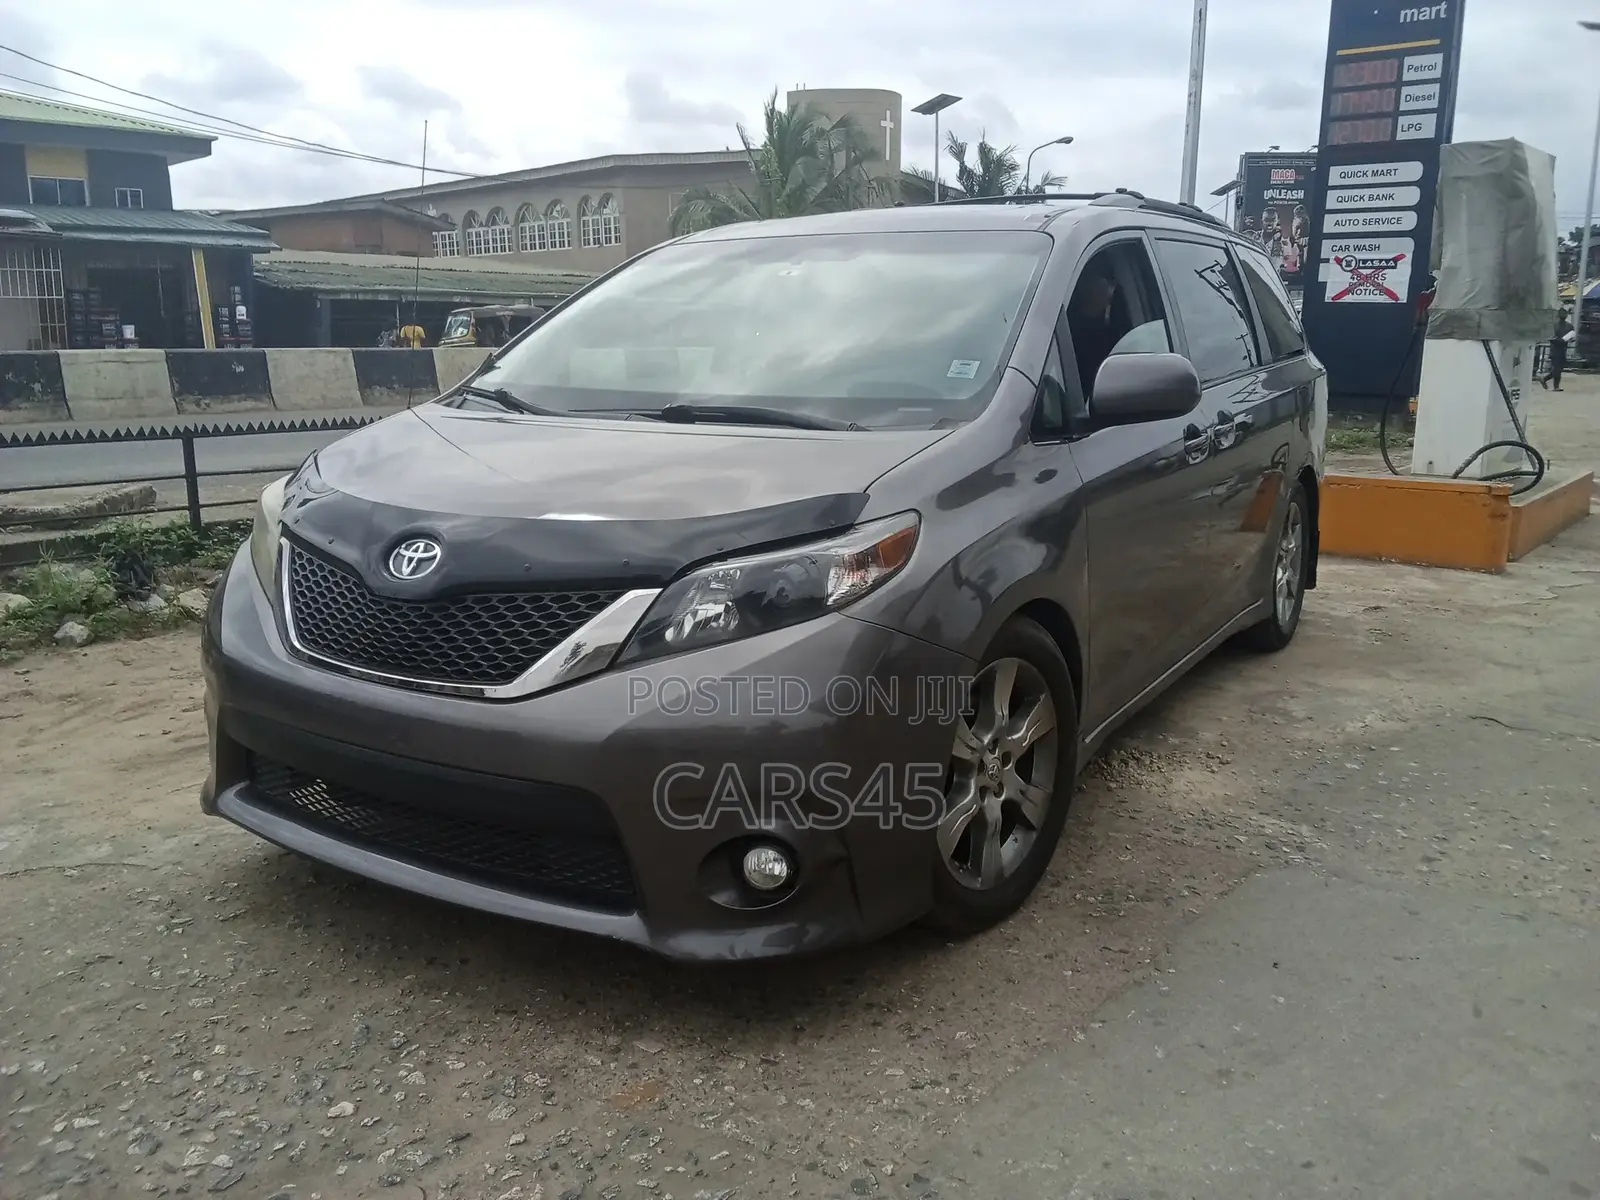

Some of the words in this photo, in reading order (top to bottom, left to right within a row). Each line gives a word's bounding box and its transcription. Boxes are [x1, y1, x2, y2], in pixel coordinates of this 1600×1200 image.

[1399, 1, 1447, 23] mart
[1406, 62, 1437, 73] Petrol
[1404, 92, 1436, 103] Diesel
[1400, 123, 1422, 133] LPG
[1339, 170, 1369, 179] QUICK
[1370, 168, 1398, 177] MART
[1263, 188, 1305, 200] UNLEASH
[1336, 194, 1366, 203] QUICK
[1367, 193, 1395, 202] BANK
[1333, 218, 1360, 227] AUTO
[1361, 216, 1403, 226] SERVICE
[1331, 244, 1351, 253] CAR
[1353, 243, 1381, 252] WASH
[1359, 259, 1396, 267] LASAA
[1347, 288, 1385, 296] NOTICE
